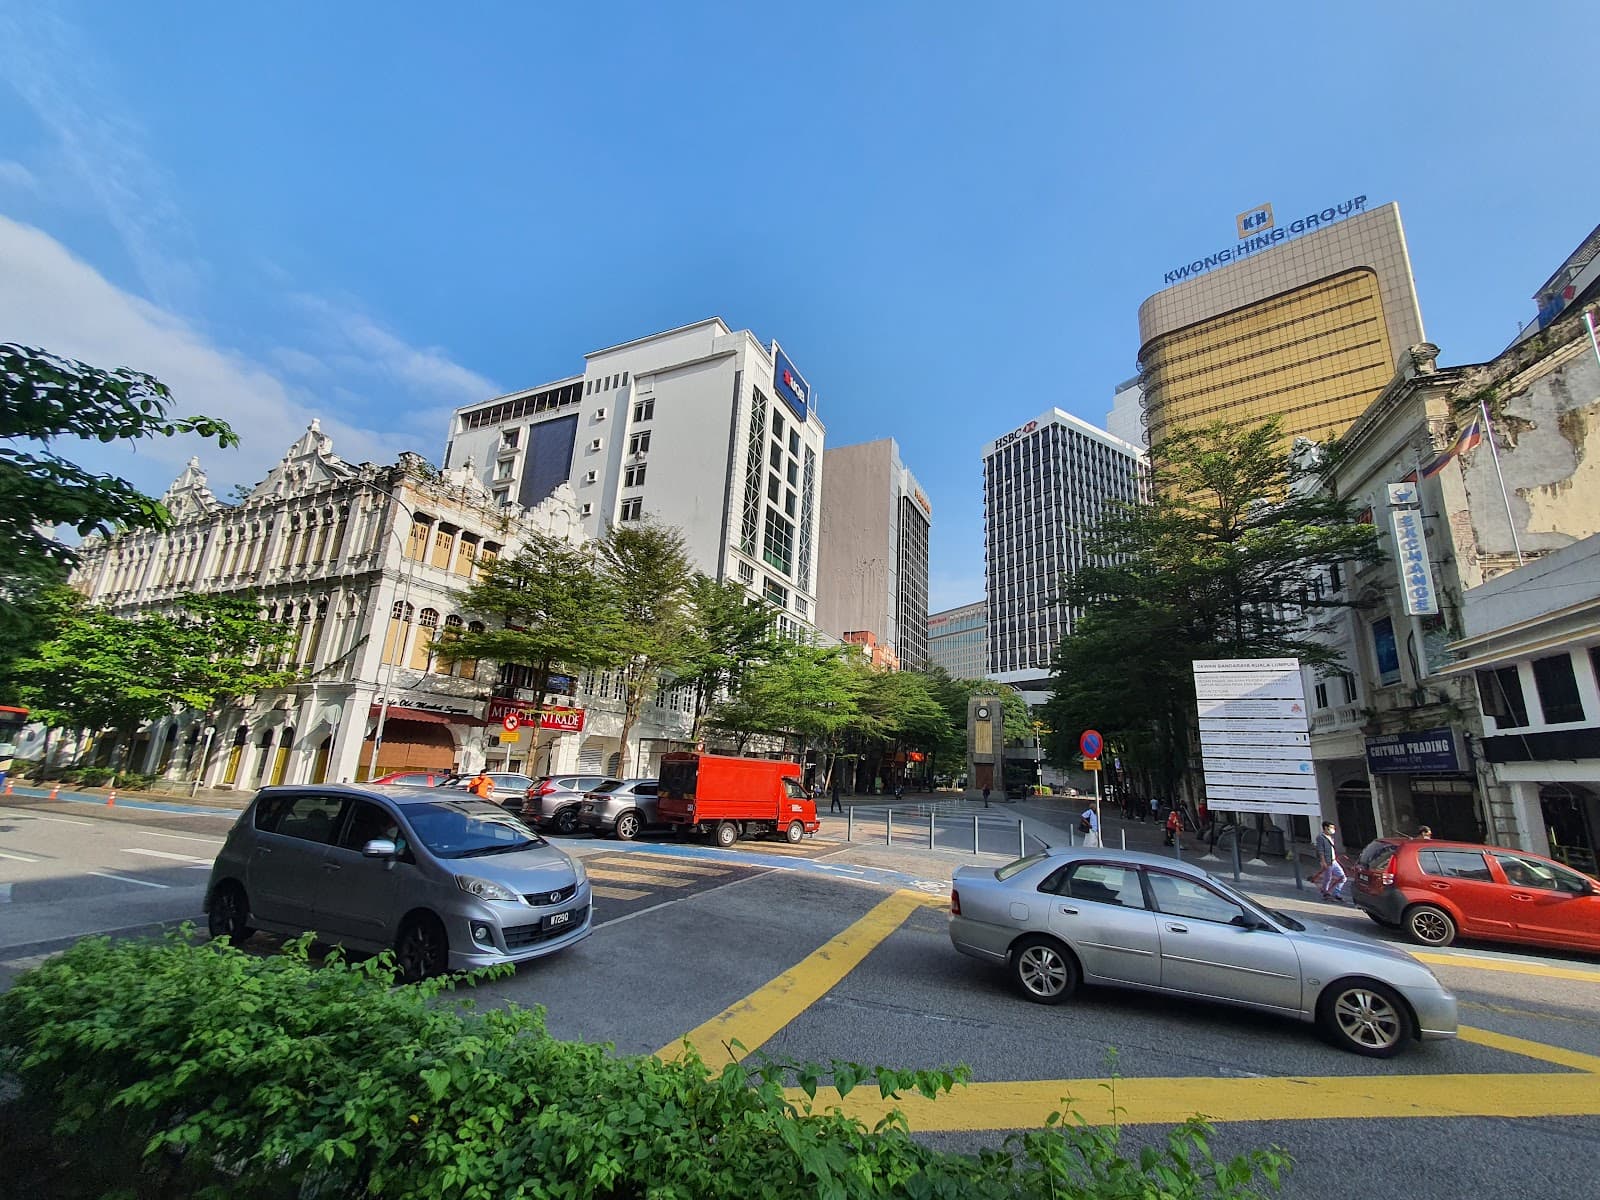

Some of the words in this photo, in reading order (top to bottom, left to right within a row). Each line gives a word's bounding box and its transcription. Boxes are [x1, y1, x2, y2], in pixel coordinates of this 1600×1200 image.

[1242, 210, 1268, 231] KH
[1163, 248, 1232, 284] KWONG
[1236, 227, 1286, 257] HING
[1290, 195, 1367, 234] GROUP
[995, 428, 1022, 450] HSBC
[1400, 514, 1430, 612] EXCHANGE
[492, 705, 580, 726] MERCHNTRADE
[1370, 744, 1405, 757] CHITWAN
[1407, 739, 1449, 754] TRADING
